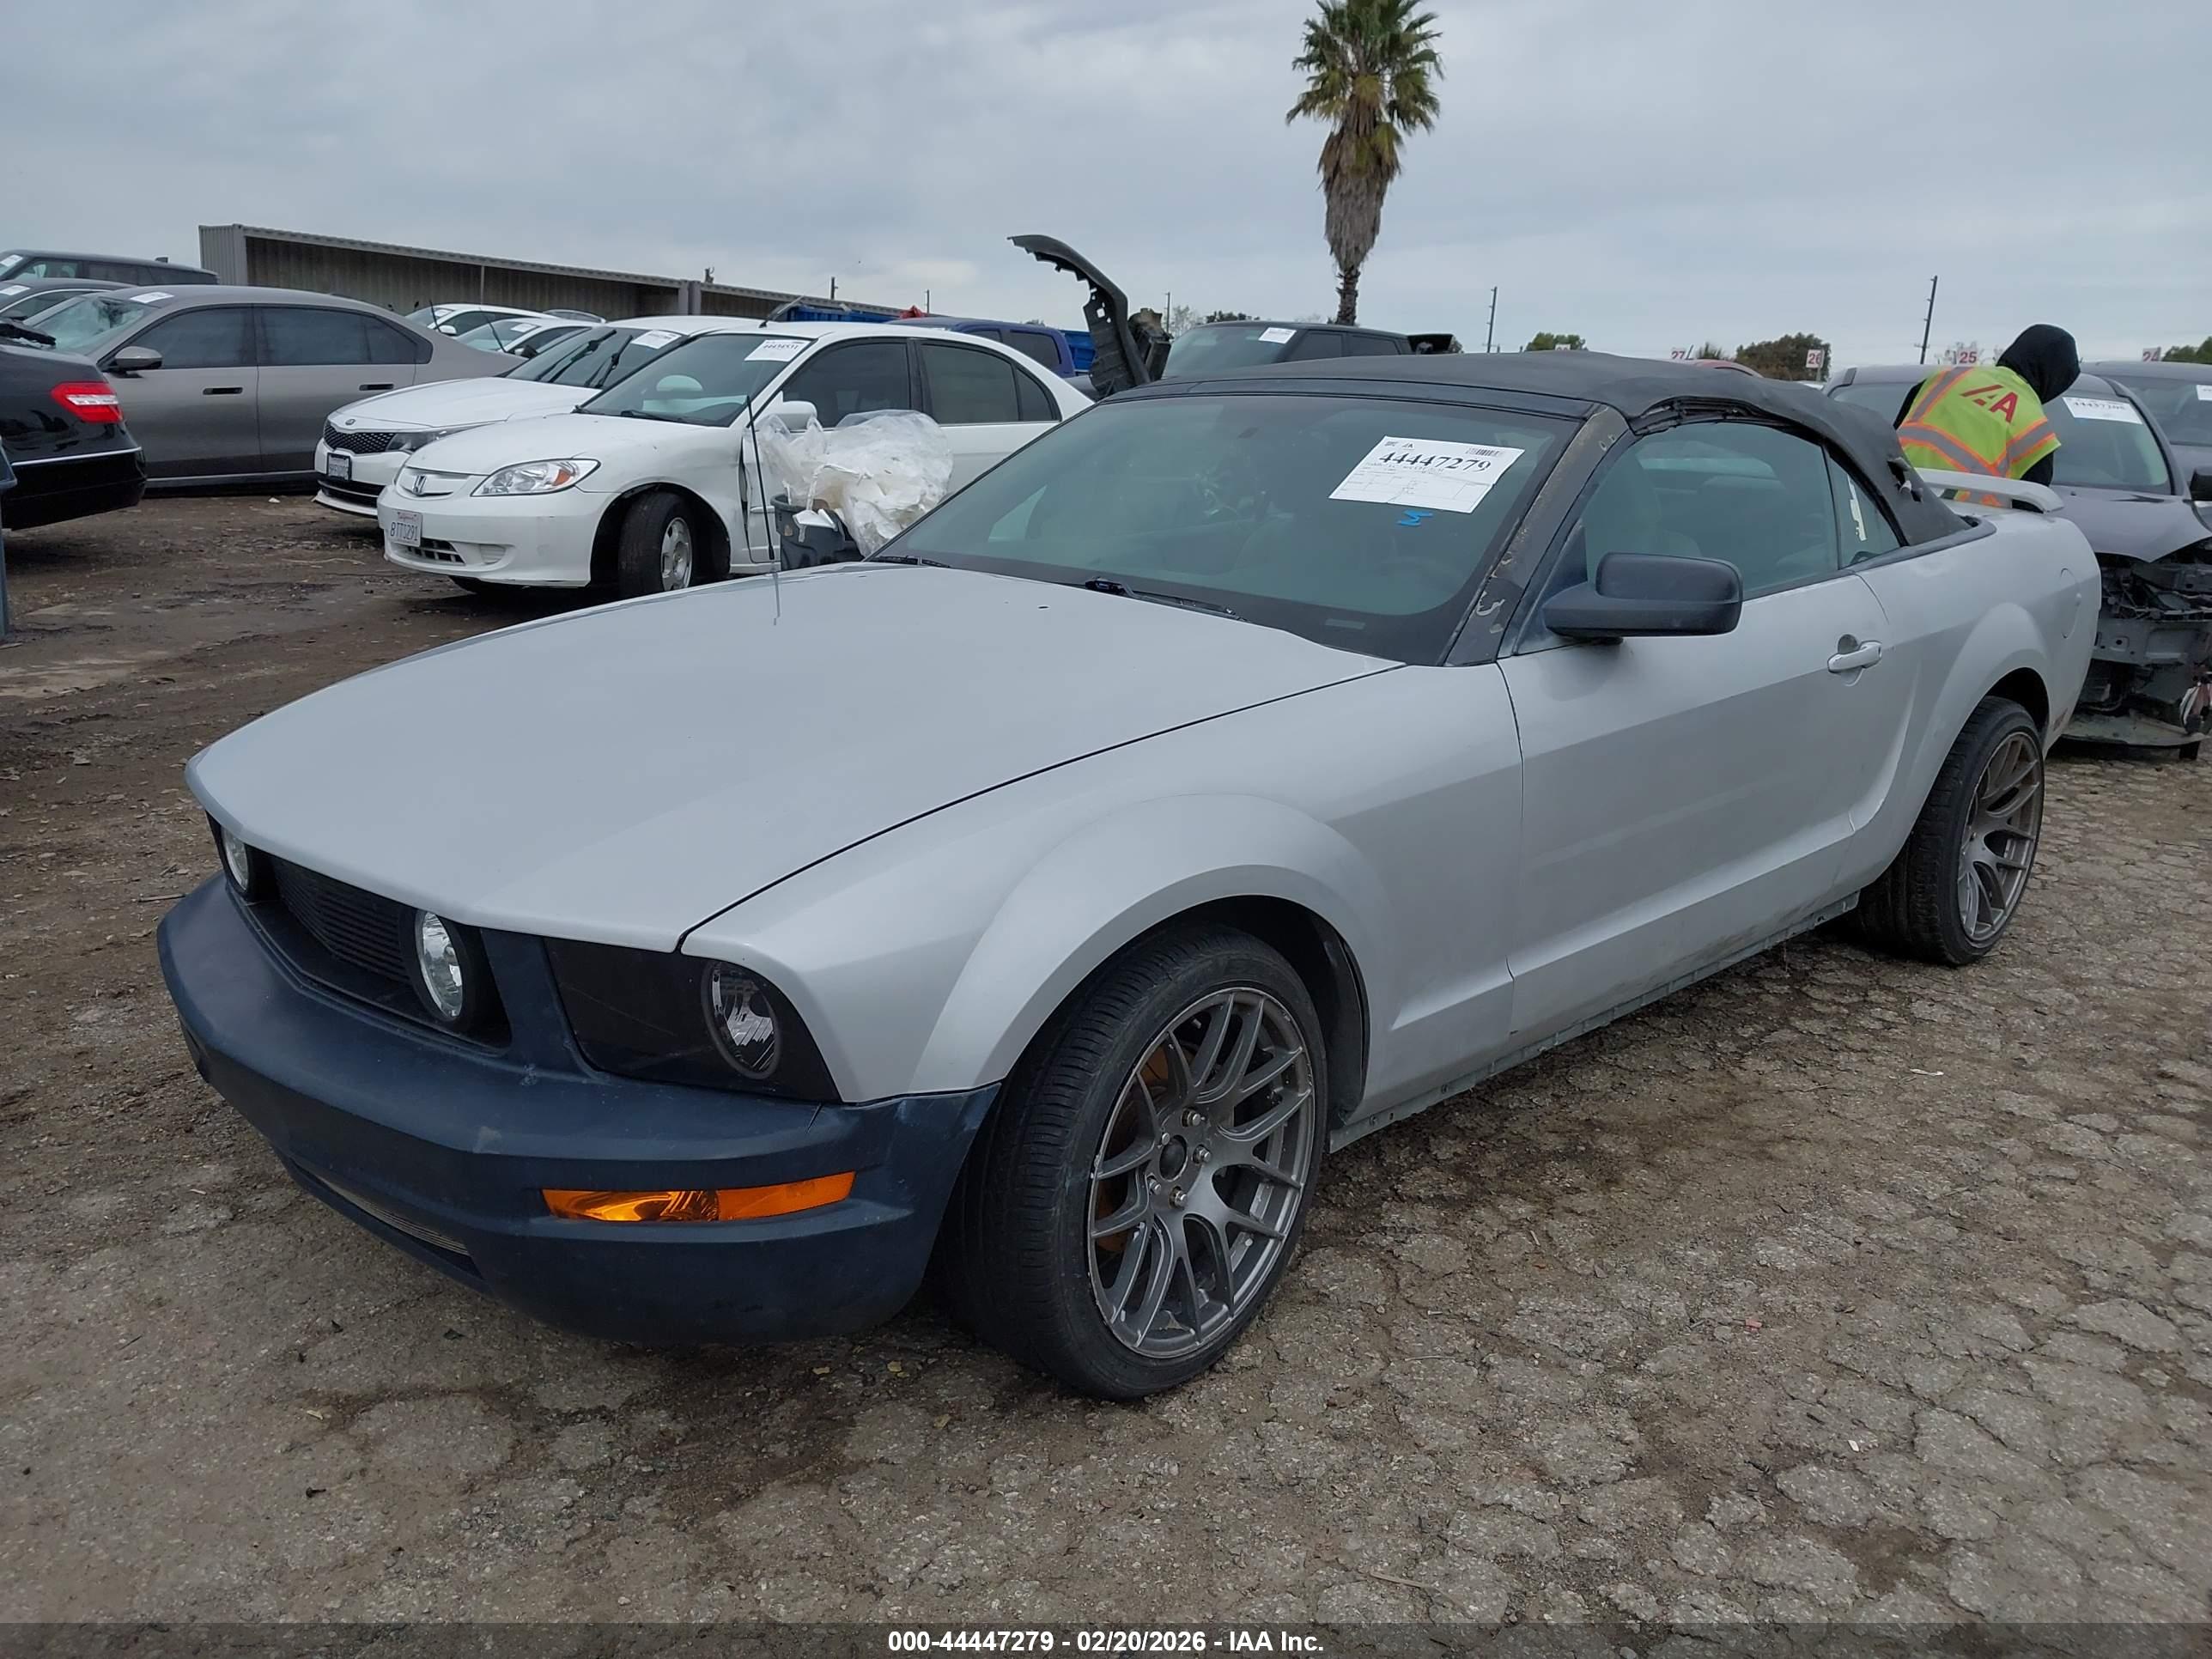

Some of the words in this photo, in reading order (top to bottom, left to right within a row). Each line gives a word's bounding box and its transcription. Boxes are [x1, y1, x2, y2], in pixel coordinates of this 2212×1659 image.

[1671, 350, 1685, 360] 27
[1959, 350, 1977, 364] 25
[1378, 452, 1492, 473] 44447279
